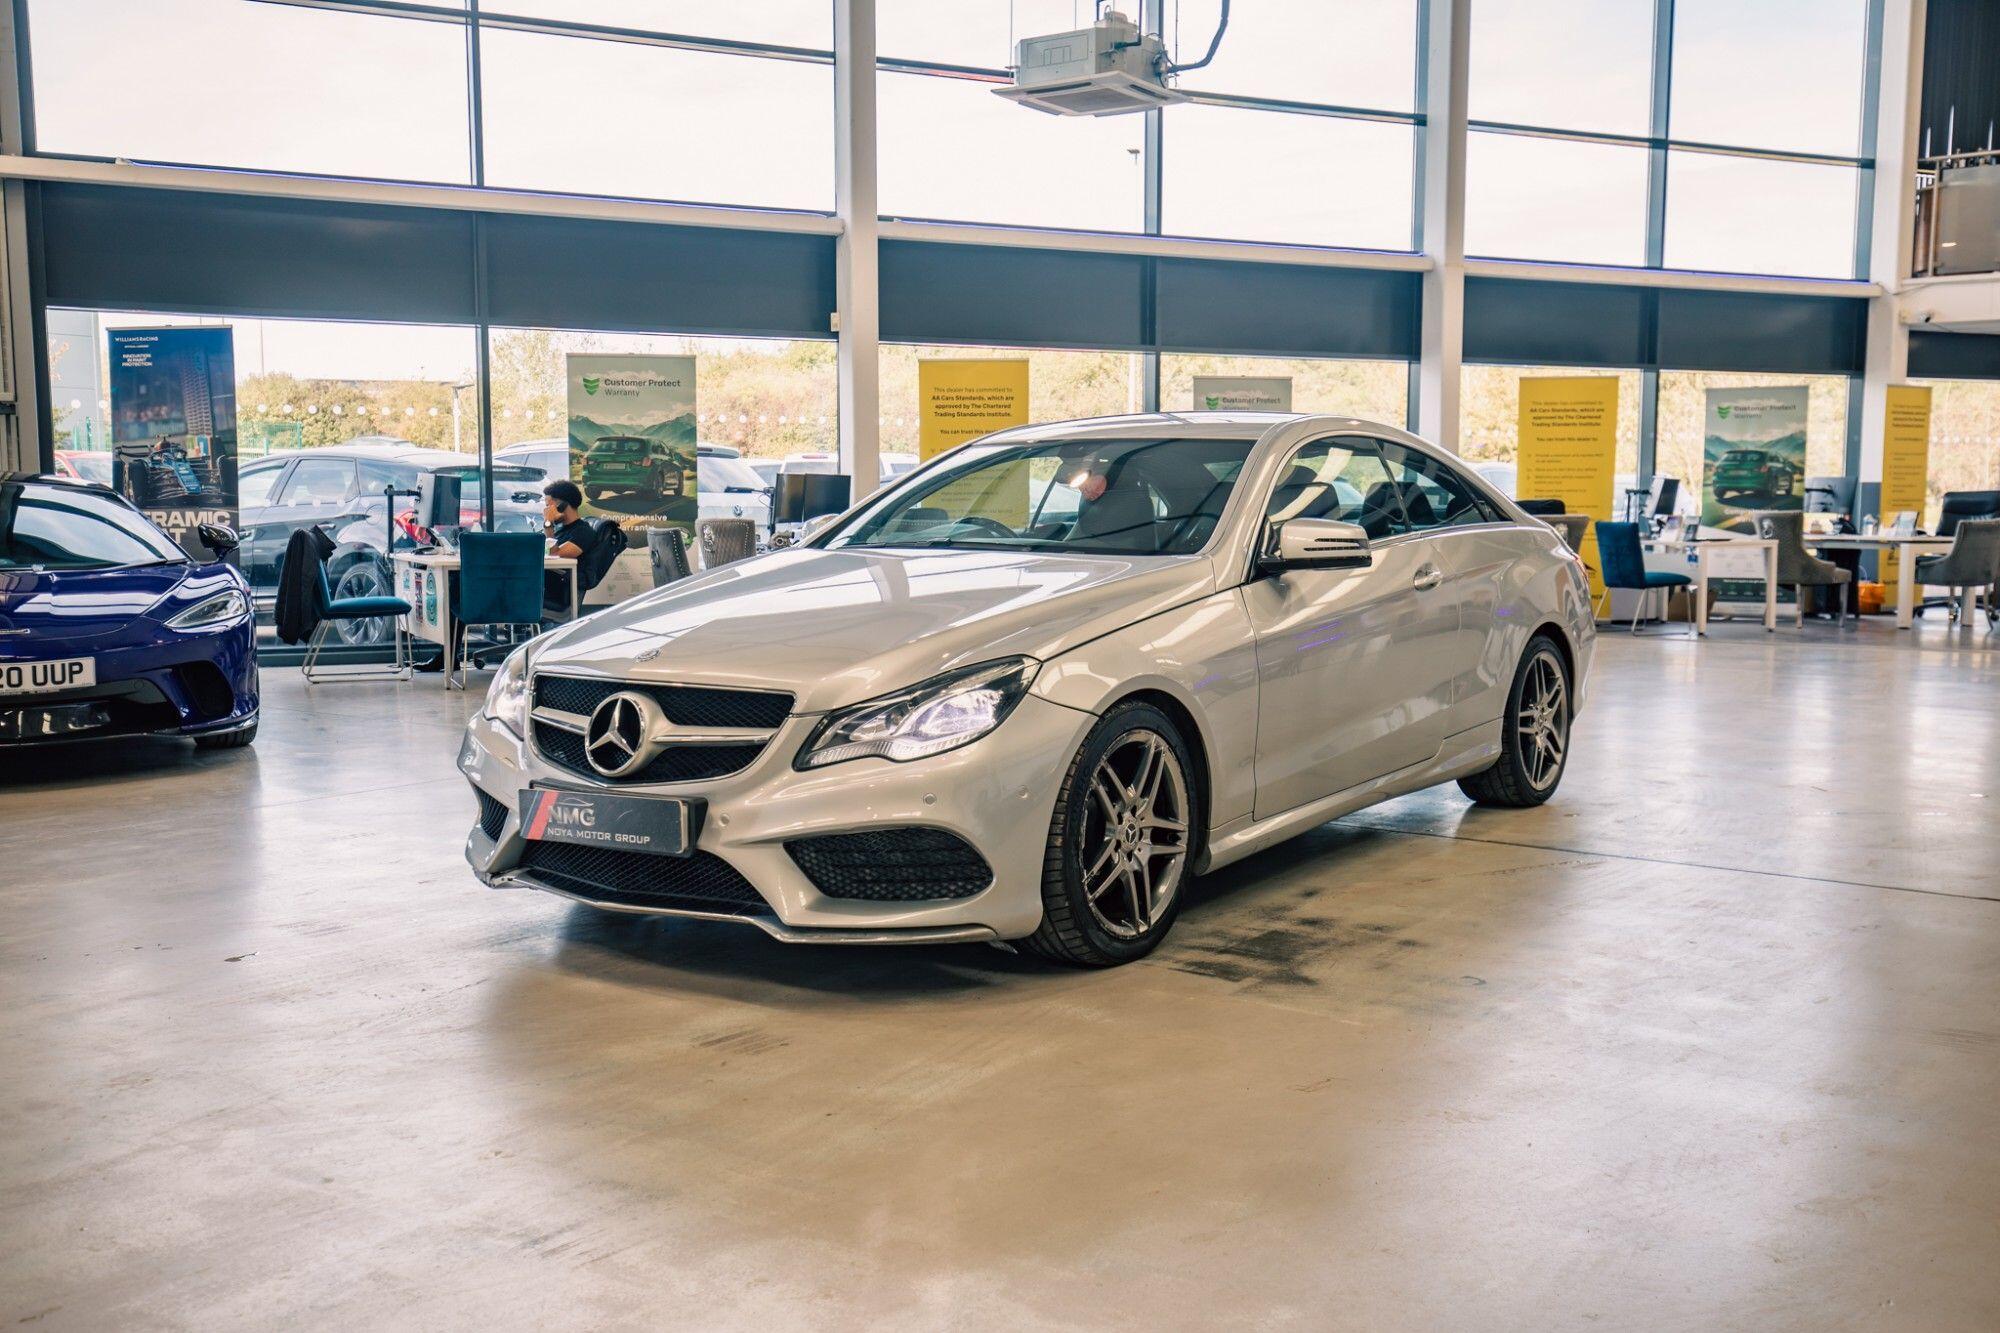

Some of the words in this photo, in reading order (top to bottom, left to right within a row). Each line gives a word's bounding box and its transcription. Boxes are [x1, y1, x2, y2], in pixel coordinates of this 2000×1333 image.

[604, 378, 647, 387] Customer
[648, 379, 681, 388] Protect
[604, 389, 640, 398] Warranty
[143, 510, 231, 527] RAMIC
[601, 513, 668, 522] Comprehensive
[0, 665, 23, 689] 0
[31, 661, 84, 687] UUP
[548, 805, 595, 827] NMG
[547, 827, 573, 838] NOYA
[576, 830, 611, 841] MOTOR
[614, 833, 650, 845] GROUP
